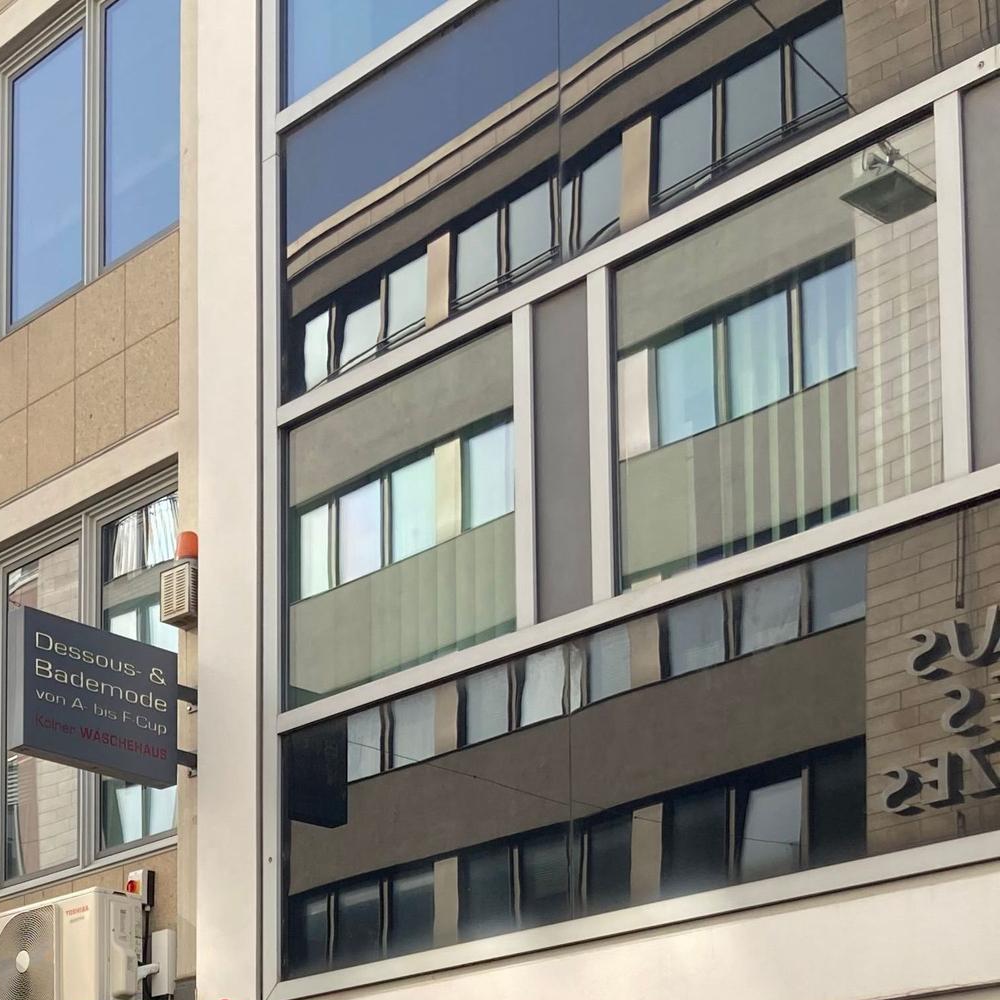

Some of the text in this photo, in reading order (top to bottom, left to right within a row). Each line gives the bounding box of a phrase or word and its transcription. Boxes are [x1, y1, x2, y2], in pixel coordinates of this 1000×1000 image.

[35, 631, 167, 685] Dessous- &
[35, 658, 167, 712] Bademode
[35, 689, 167, 735] von A- bis F-Cup
